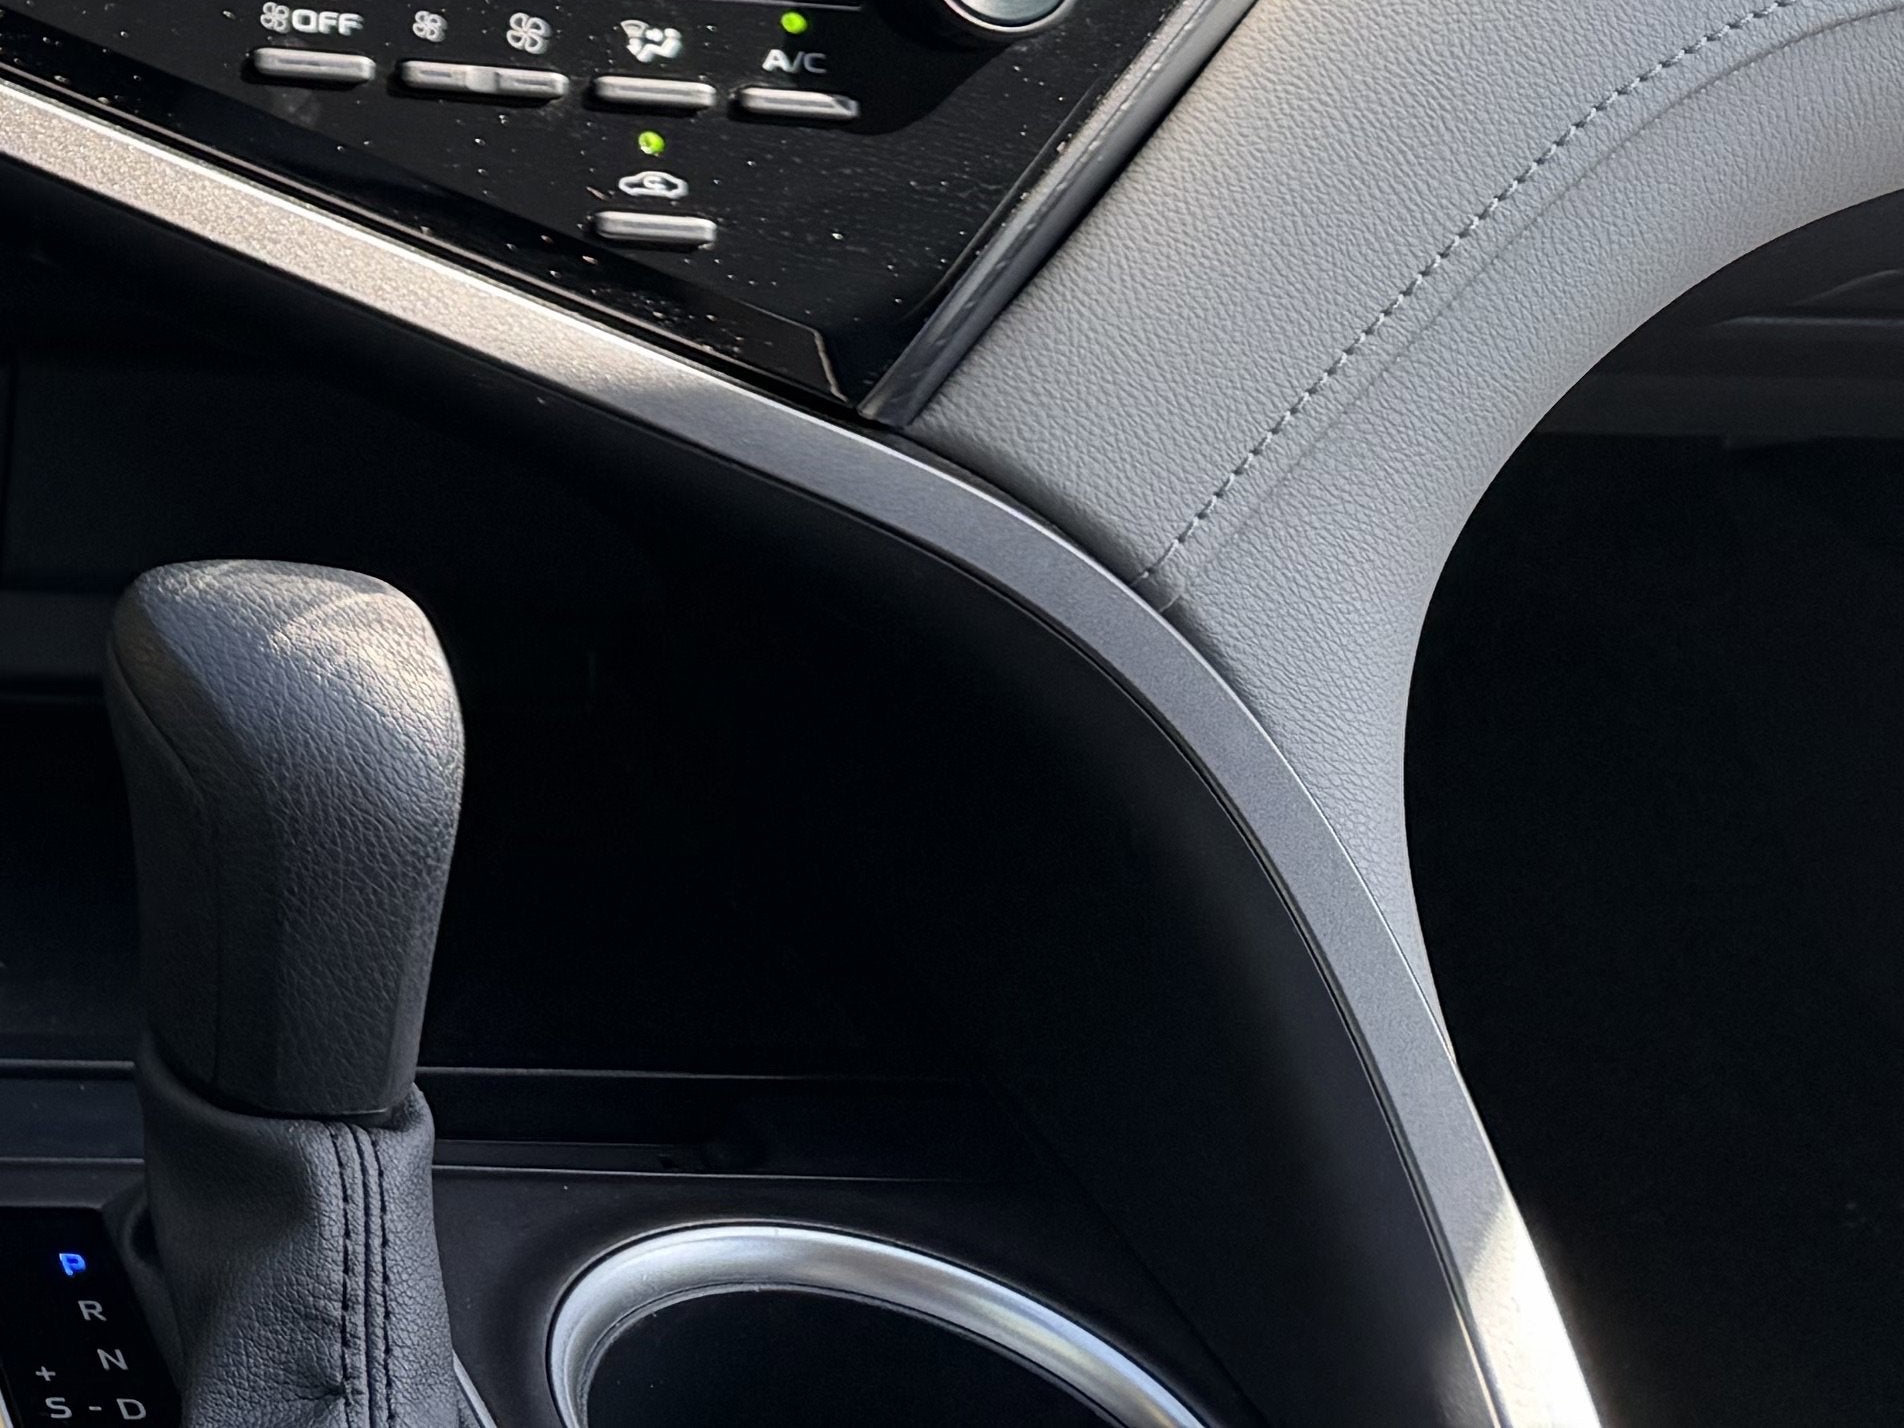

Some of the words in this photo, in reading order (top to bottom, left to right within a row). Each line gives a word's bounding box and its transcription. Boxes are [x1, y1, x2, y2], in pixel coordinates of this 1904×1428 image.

[292, 8, 365, 37] OFF
[762, 49, 828, 74] A/C
[59, 1253, 87, 1276] P
[78, 1300, 107, 1322] R
[97, 1349, 128, 1371] N
[45, 1397, 73, 1420] S
[116, 1398, 147, 1421] D
